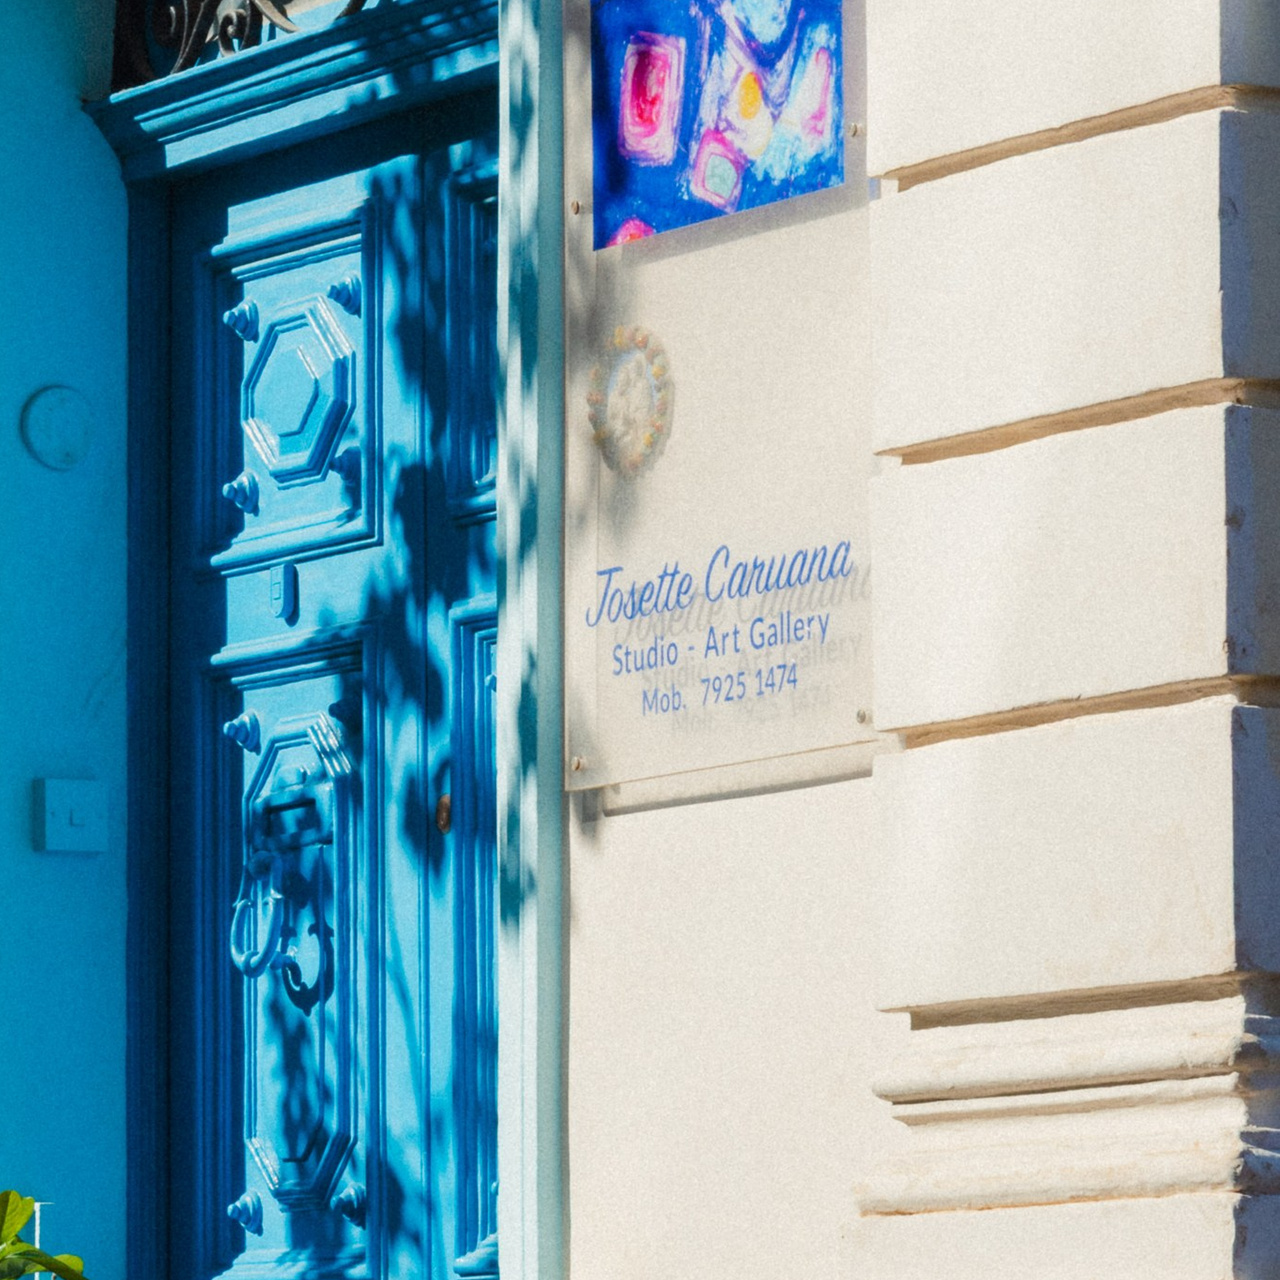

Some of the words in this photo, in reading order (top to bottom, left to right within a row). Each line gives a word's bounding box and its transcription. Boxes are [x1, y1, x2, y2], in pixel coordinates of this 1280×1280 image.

[586, 560, 693, 627] Josette
[705, 540, 851, 602] Caruana
[613, 636, 678, 675] Studio
[704, 623, 740, 658] Art
[750, 610, 830, 650] Gallery
[642, 683, 686, 716] Mob.
[701, 671, 746, 706] 7925
[756, 663, 798, 696] 1474
